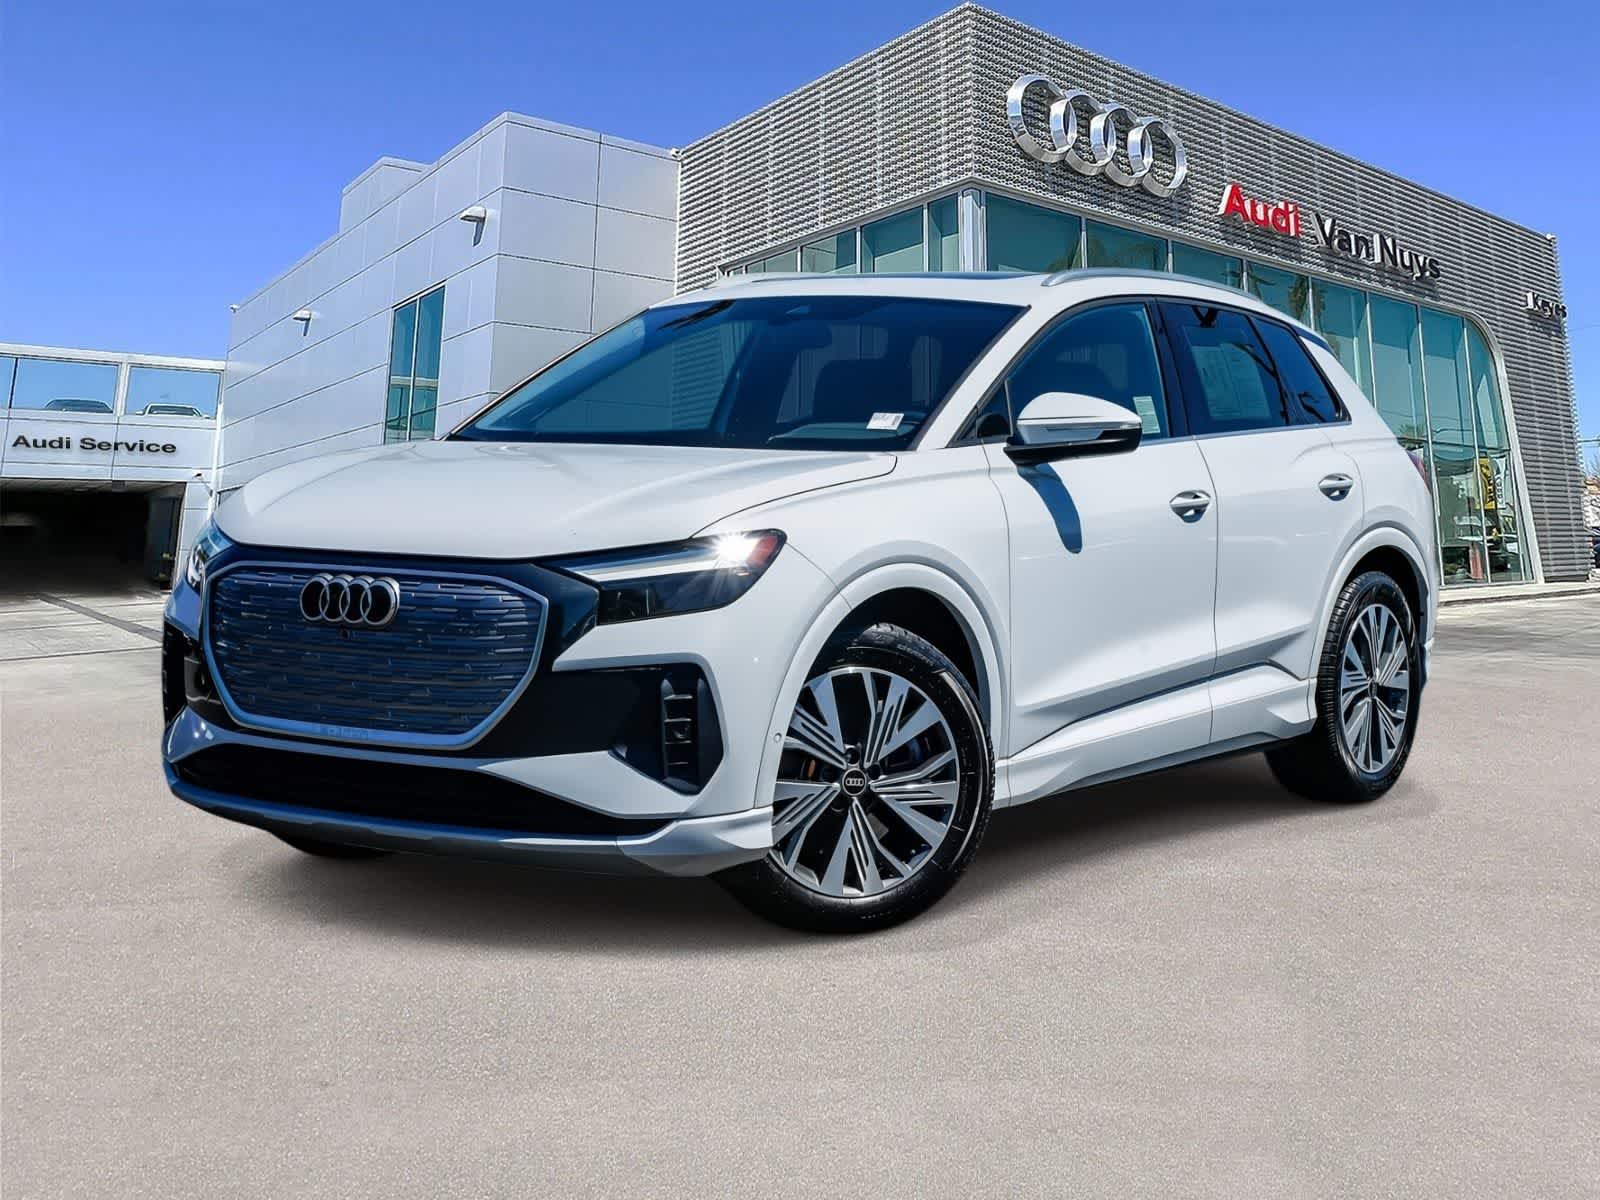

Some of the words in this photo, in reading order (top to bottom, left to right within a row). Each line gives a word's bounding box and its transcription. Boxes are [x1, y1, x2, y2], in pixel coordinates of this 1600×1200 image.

[1218, 182, 1300, 238] Audi
[1311, 212, 1370, 260] Van
[1375, 233, 1441, 281] Nuys
[1528, 291, 1567, 319] Keyes
[12, 435, 71, 449] Audi
[80, 437, 177, 454] Service
